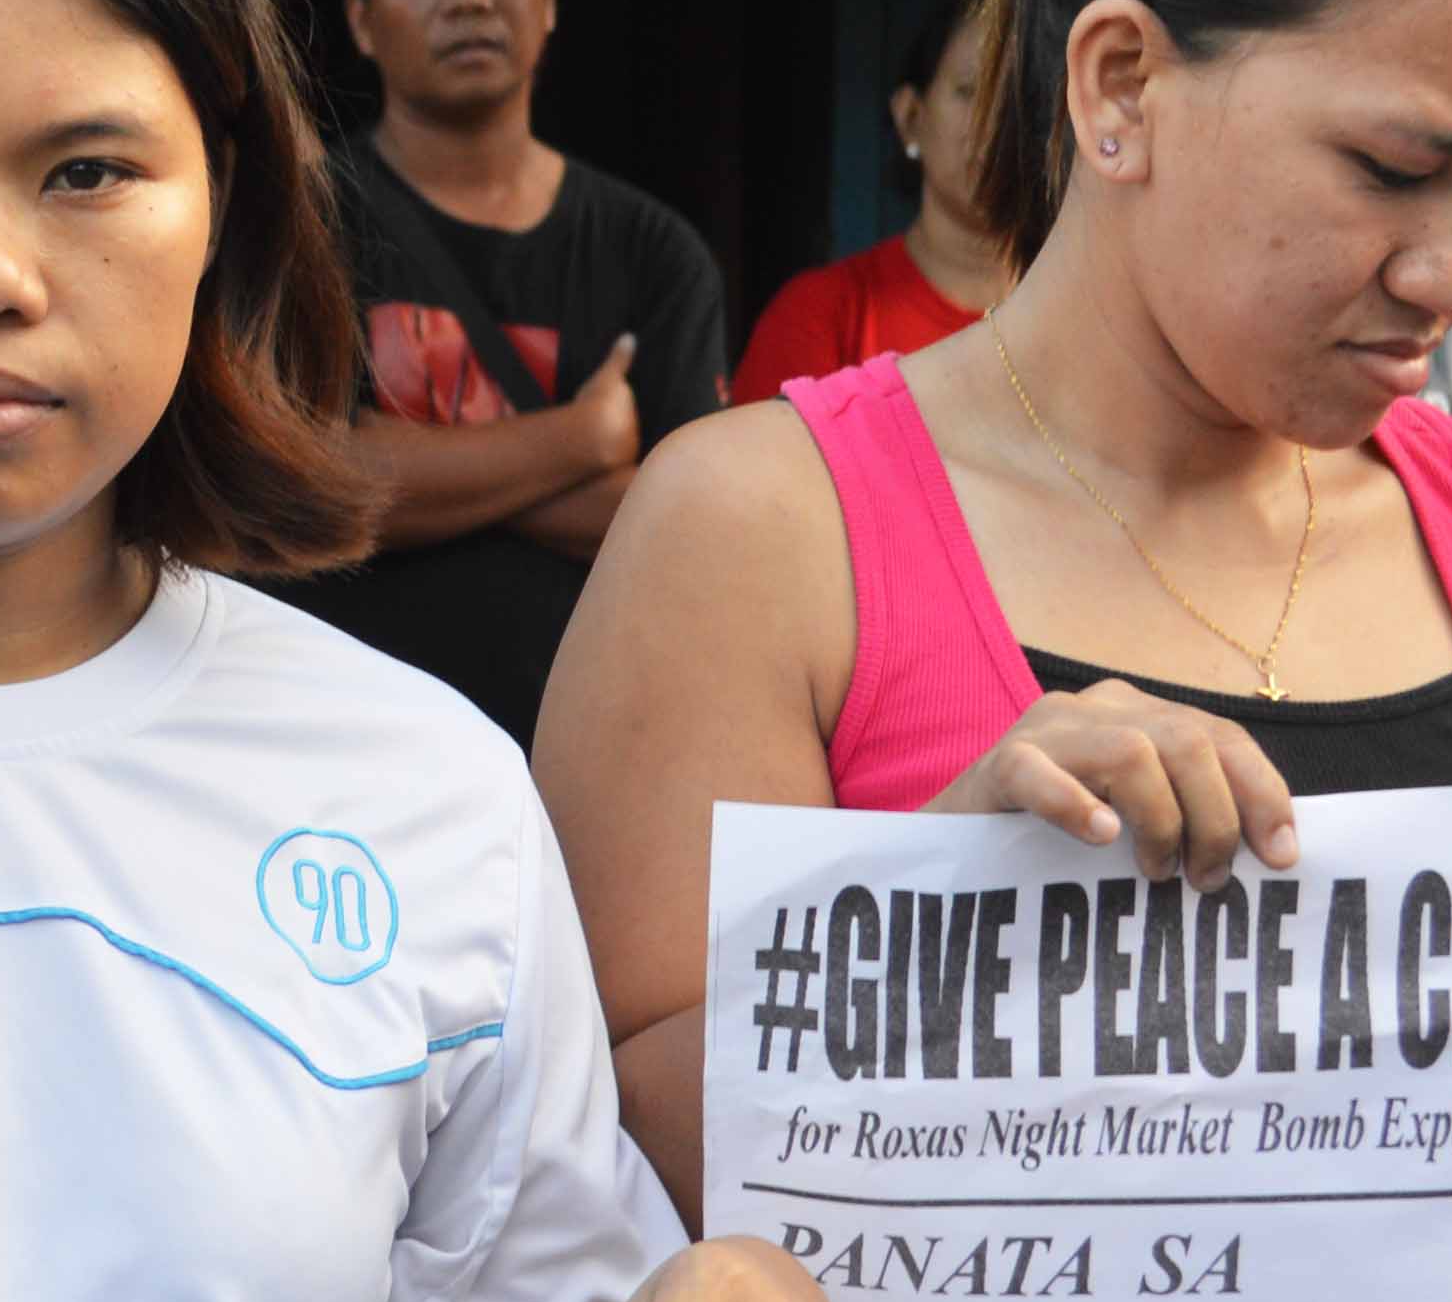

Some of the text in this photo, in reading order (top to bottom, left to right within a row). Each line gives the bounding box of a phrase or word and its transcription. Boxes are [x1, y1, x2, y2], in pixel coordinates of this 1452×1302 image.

[292, 858, 372, 952] 90
[752, 884, 1019, 1080] #GIVE
[1037, 874, 1300, 1078] PEACE
[1318, 875, 1374, 1069] A
[777, 1105, 843, 1165] for
[851, 1107, 966, 1159] Roxas
[978, 1104, 1088, 1169] Night
[1094, 1102, 1234, 1157] Market
[1256, 1101, 1365, 1156] Bomb
[779, 1221, 1245, 1297] PANATA SA
